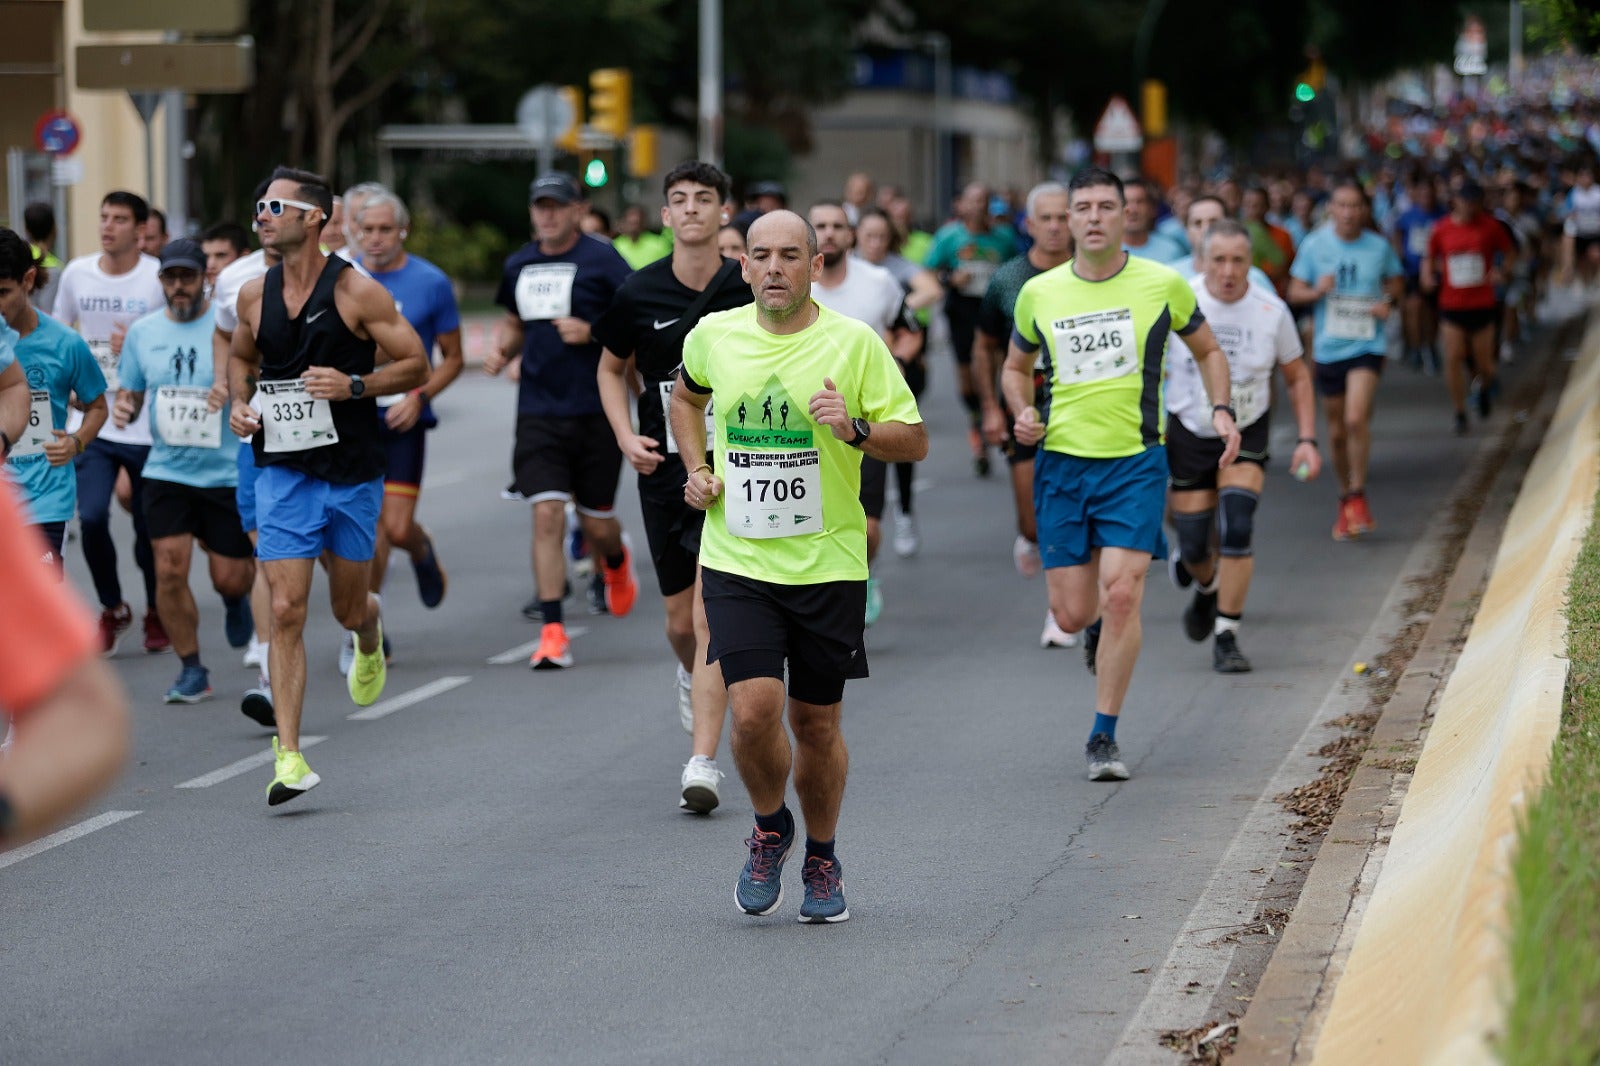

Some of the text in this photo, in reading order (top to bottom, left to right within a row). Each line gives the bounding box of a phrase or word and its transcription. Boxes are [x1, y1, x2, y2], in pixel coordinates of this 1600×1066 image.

[1070, 330, 1122, 353] 3246
[260, 383, 275, 394] 43
[170, 405, 208, 421] 1747
[273, 400, 315, 422] 3337
[774, 435, 808, 444] TEAMS
[728, 452, 750, 468] 43
[786, 450, 818, 459] URBANA
[742, 477, 806, 502] 1706
